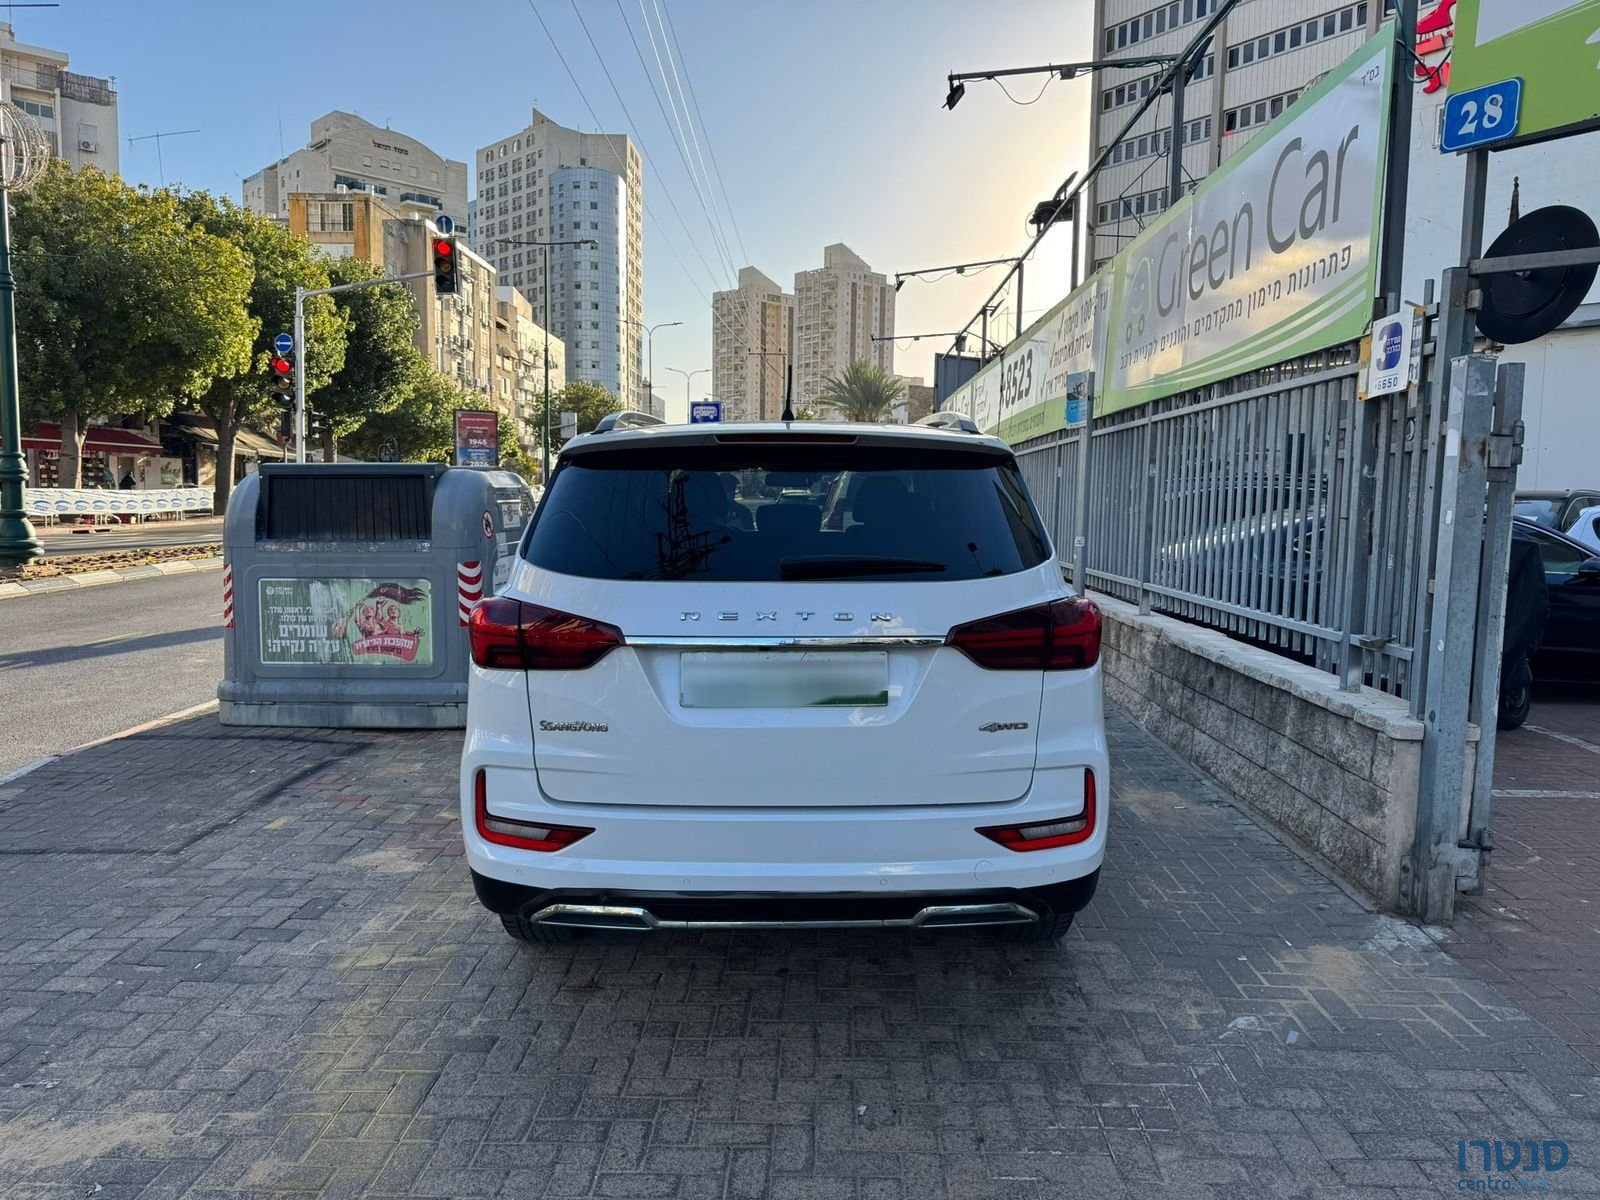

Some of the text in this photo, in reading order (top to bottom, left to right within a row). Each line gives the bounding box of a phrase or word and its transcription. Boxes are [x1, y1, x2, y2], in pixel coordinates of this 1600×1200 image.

[1457, 93, 1504, 136] 28
[1156, 125, 1359, 318] Green Car
[1119, 245, 1352, 370] פתרונות מימון מתקדמים והוגנים לקניית רכב
[679, 611, 893, 622] REXTON
[278, 624, 328, 638] שומרים
[267, 639, 306, 655] נקייה!
[978, 721, 1029, 733] 4WD
